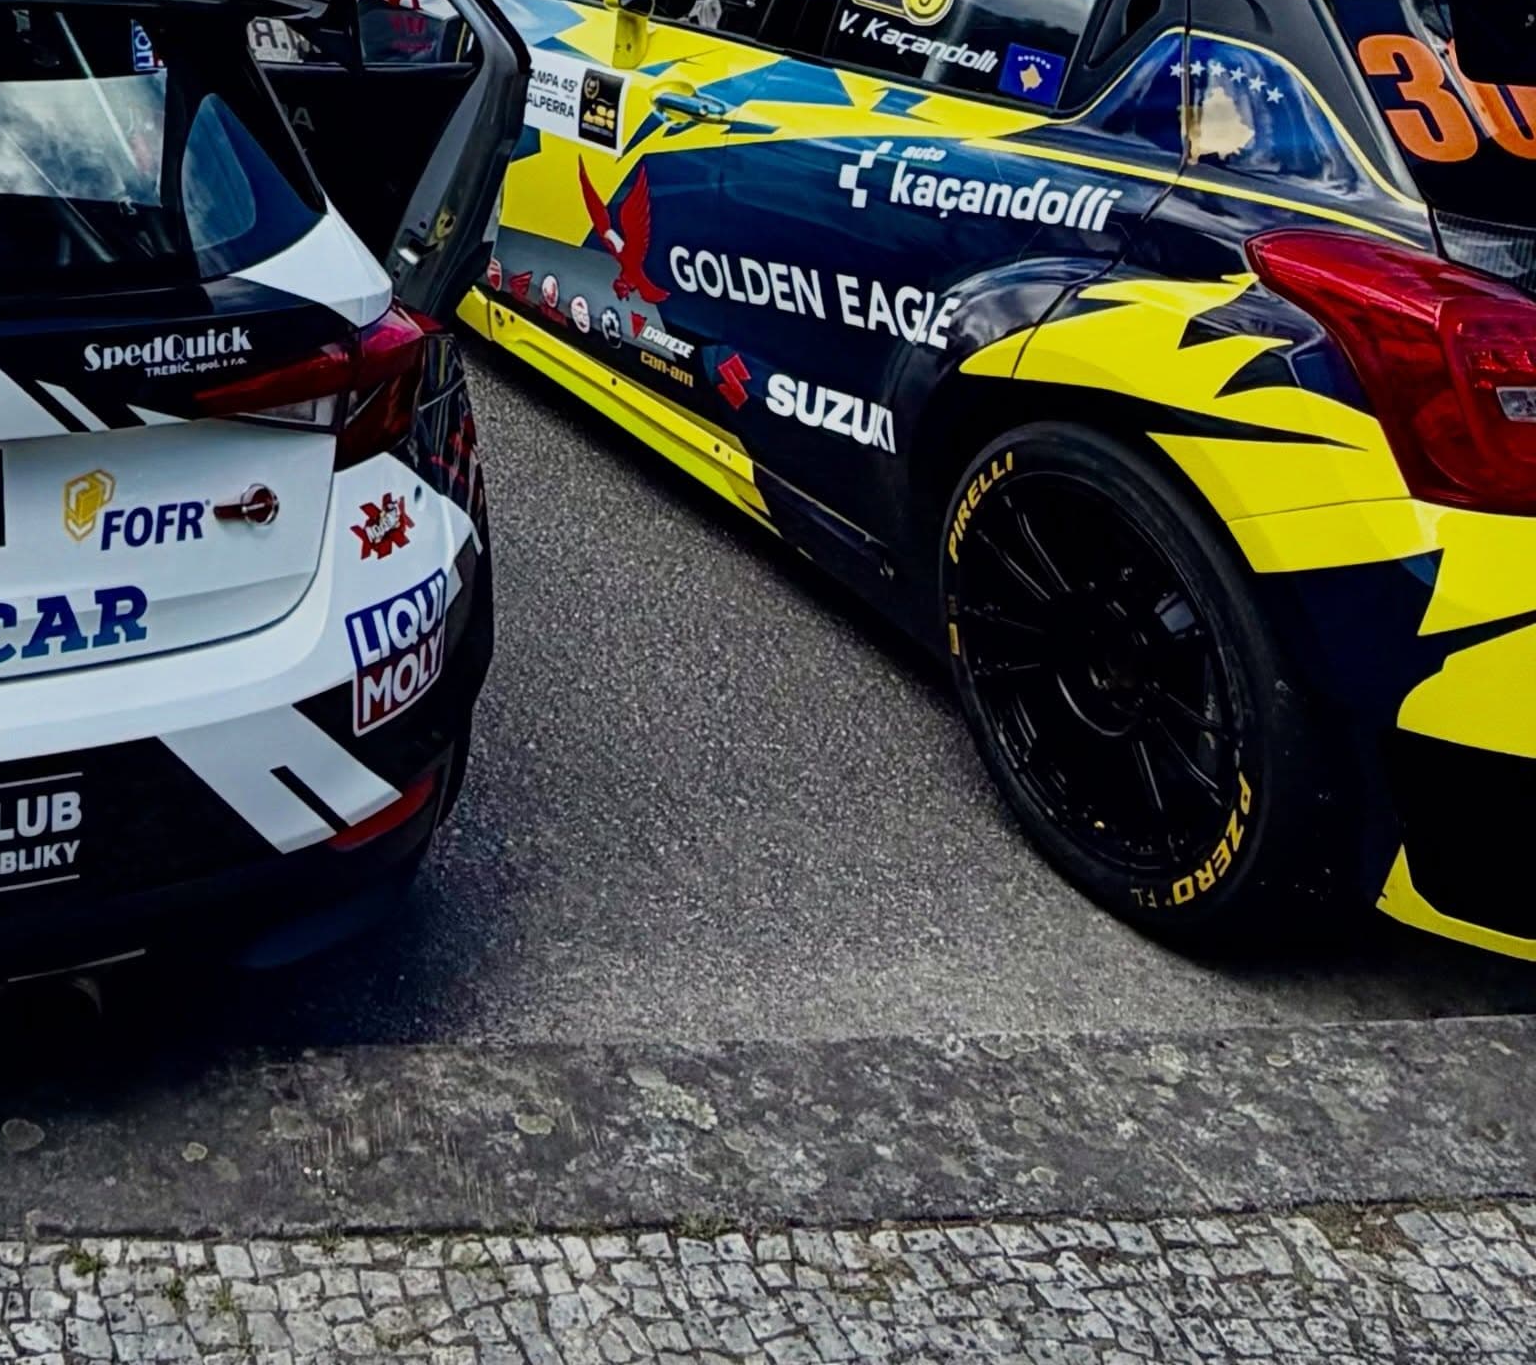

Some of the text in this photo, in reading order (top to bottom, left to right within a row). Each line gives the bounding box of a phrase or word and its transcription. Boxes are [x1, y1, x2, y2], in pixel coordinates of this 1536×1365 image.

[839, 9, 860, 34] V.
[530, 69, 559, 87] AMPA
[526, 92, 575, 119] ALPERRA
[901, 145, 947, 162] auto
[890, 160, 1123, 232] kaçandolli
[669, 245, 962, 350] GOLDEN EAGLE
[84, 326, 253, 371] SpedQuick
[640, 350, 694, 388] can-am
[765, 372, 896, 455] SUZUKI
[99, 499, 204, 551] FOFR
[948, 451, 1013, 564] PIRELLI
[351, 573, 445, 668] LIQUI
[362, 625, 442, 723] MOLY
